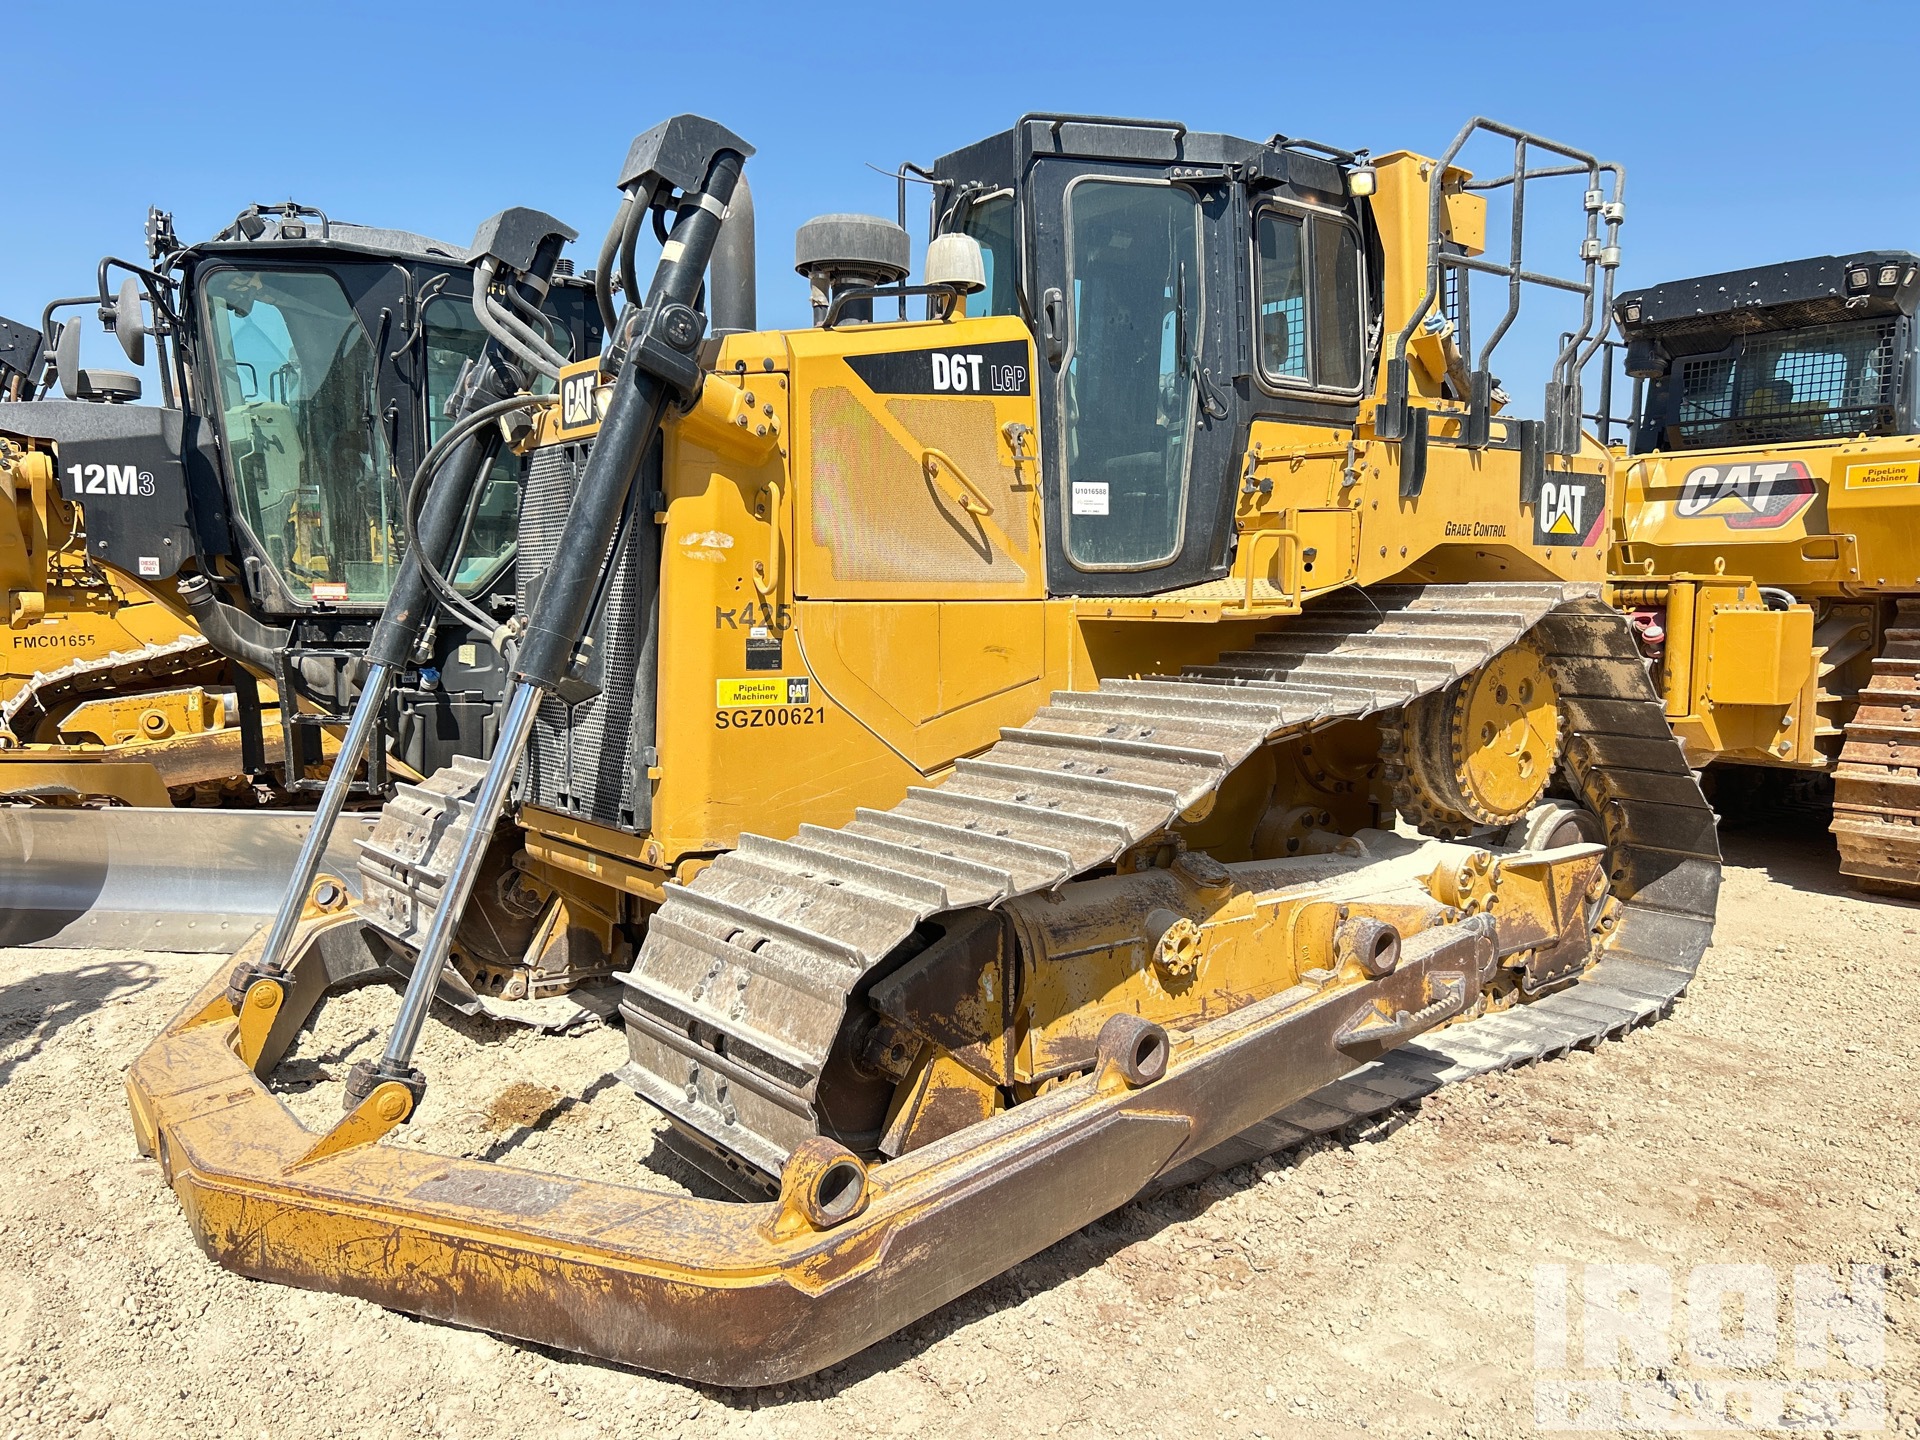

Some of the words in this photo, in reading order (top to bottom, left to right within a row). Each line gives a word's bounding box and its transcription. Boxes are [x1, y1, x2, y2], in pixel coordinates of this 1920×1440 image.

[931, 353, 983, 391] D6T
[990, 365, 1026, 392] LGP
[564, 375, 595, 423] CAT
[1862, 475, 1909, 483] Machinery
[1868, 467, 1906, 476] PipeLine
[1678, 462, 1789, 516] CAT
[1540, 482, 1586, 535] CAT
[715, 602, 791, 630] R425
[13, 634, 96, 649] FMC01655
[733, 692, 779, 701] Machinery
[738, 684, 776, 693] PipeLine
[788, 684, 809, 698] CAT
[715, 706, 824, 729] SGZ00621
